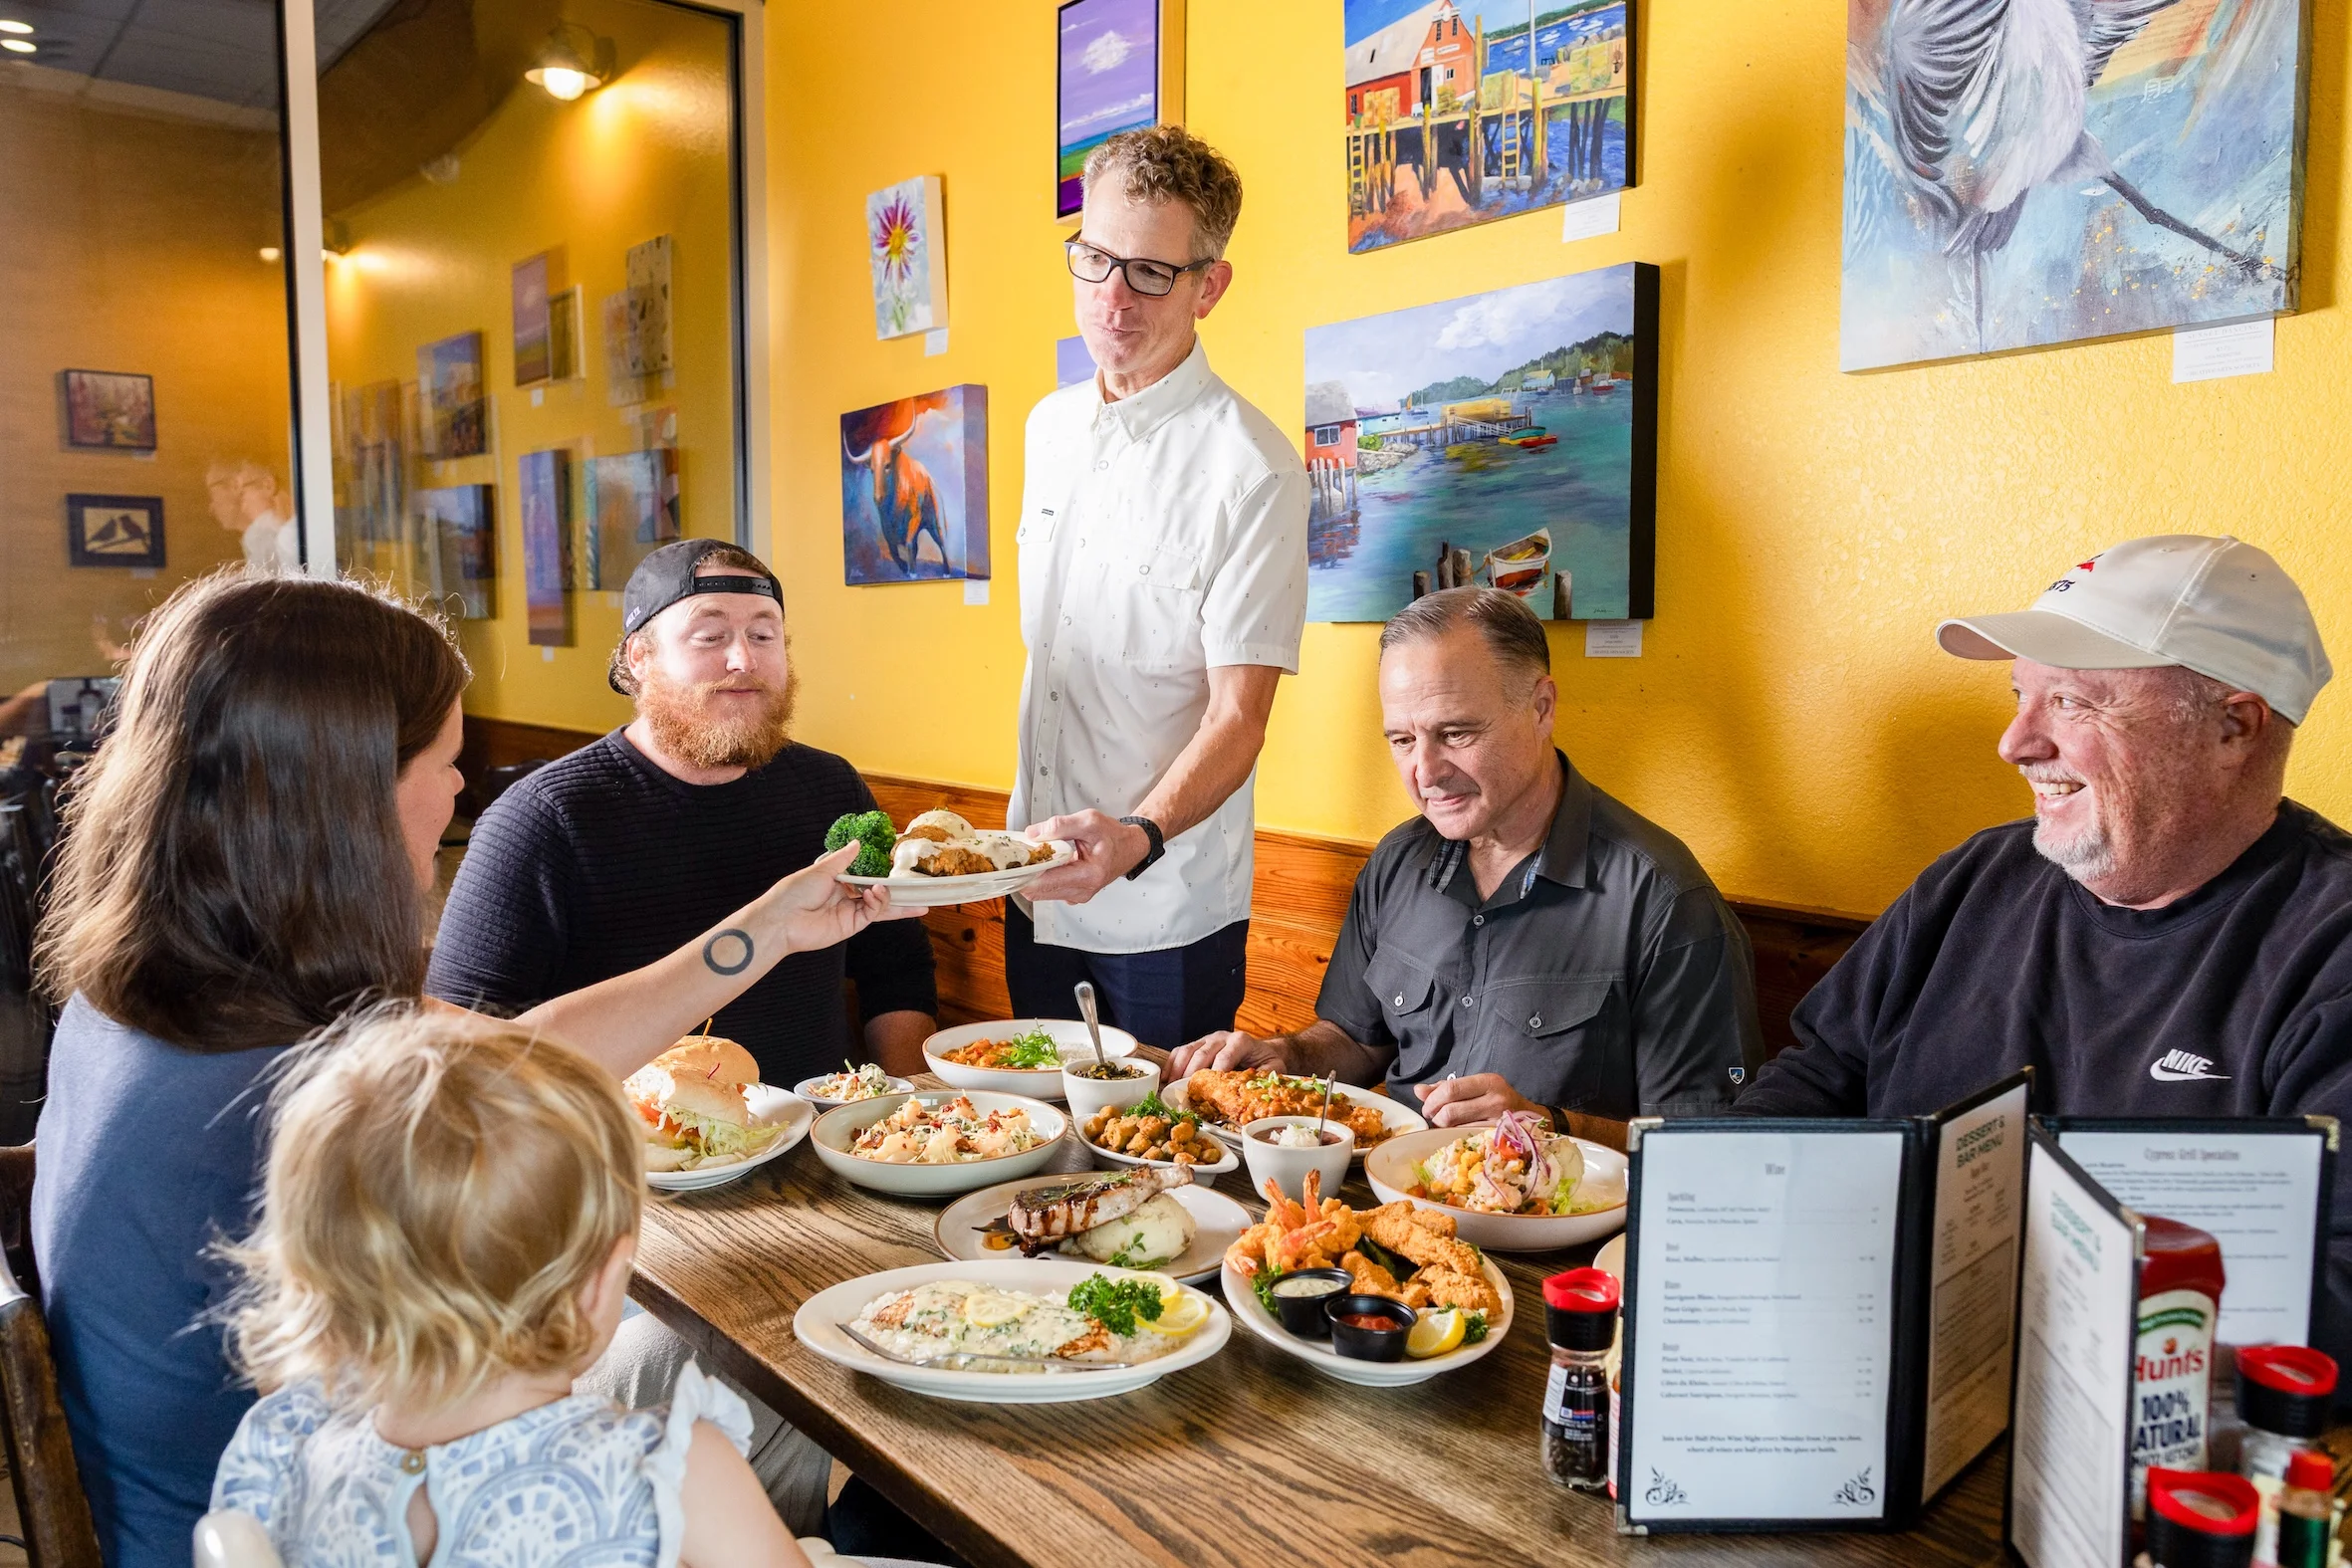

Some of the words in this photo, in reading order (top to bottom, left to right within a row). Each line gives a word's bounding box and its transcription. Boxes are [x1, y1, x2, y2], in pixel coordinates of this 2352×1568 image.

[2162, 1048, 2214, 1075] NIKE
[1764, 1163, 1785, 1175] Wine
[2142, 1389, 2189, 1422] 100%
[2133, 1413, 2201, 1452] ATURAL
